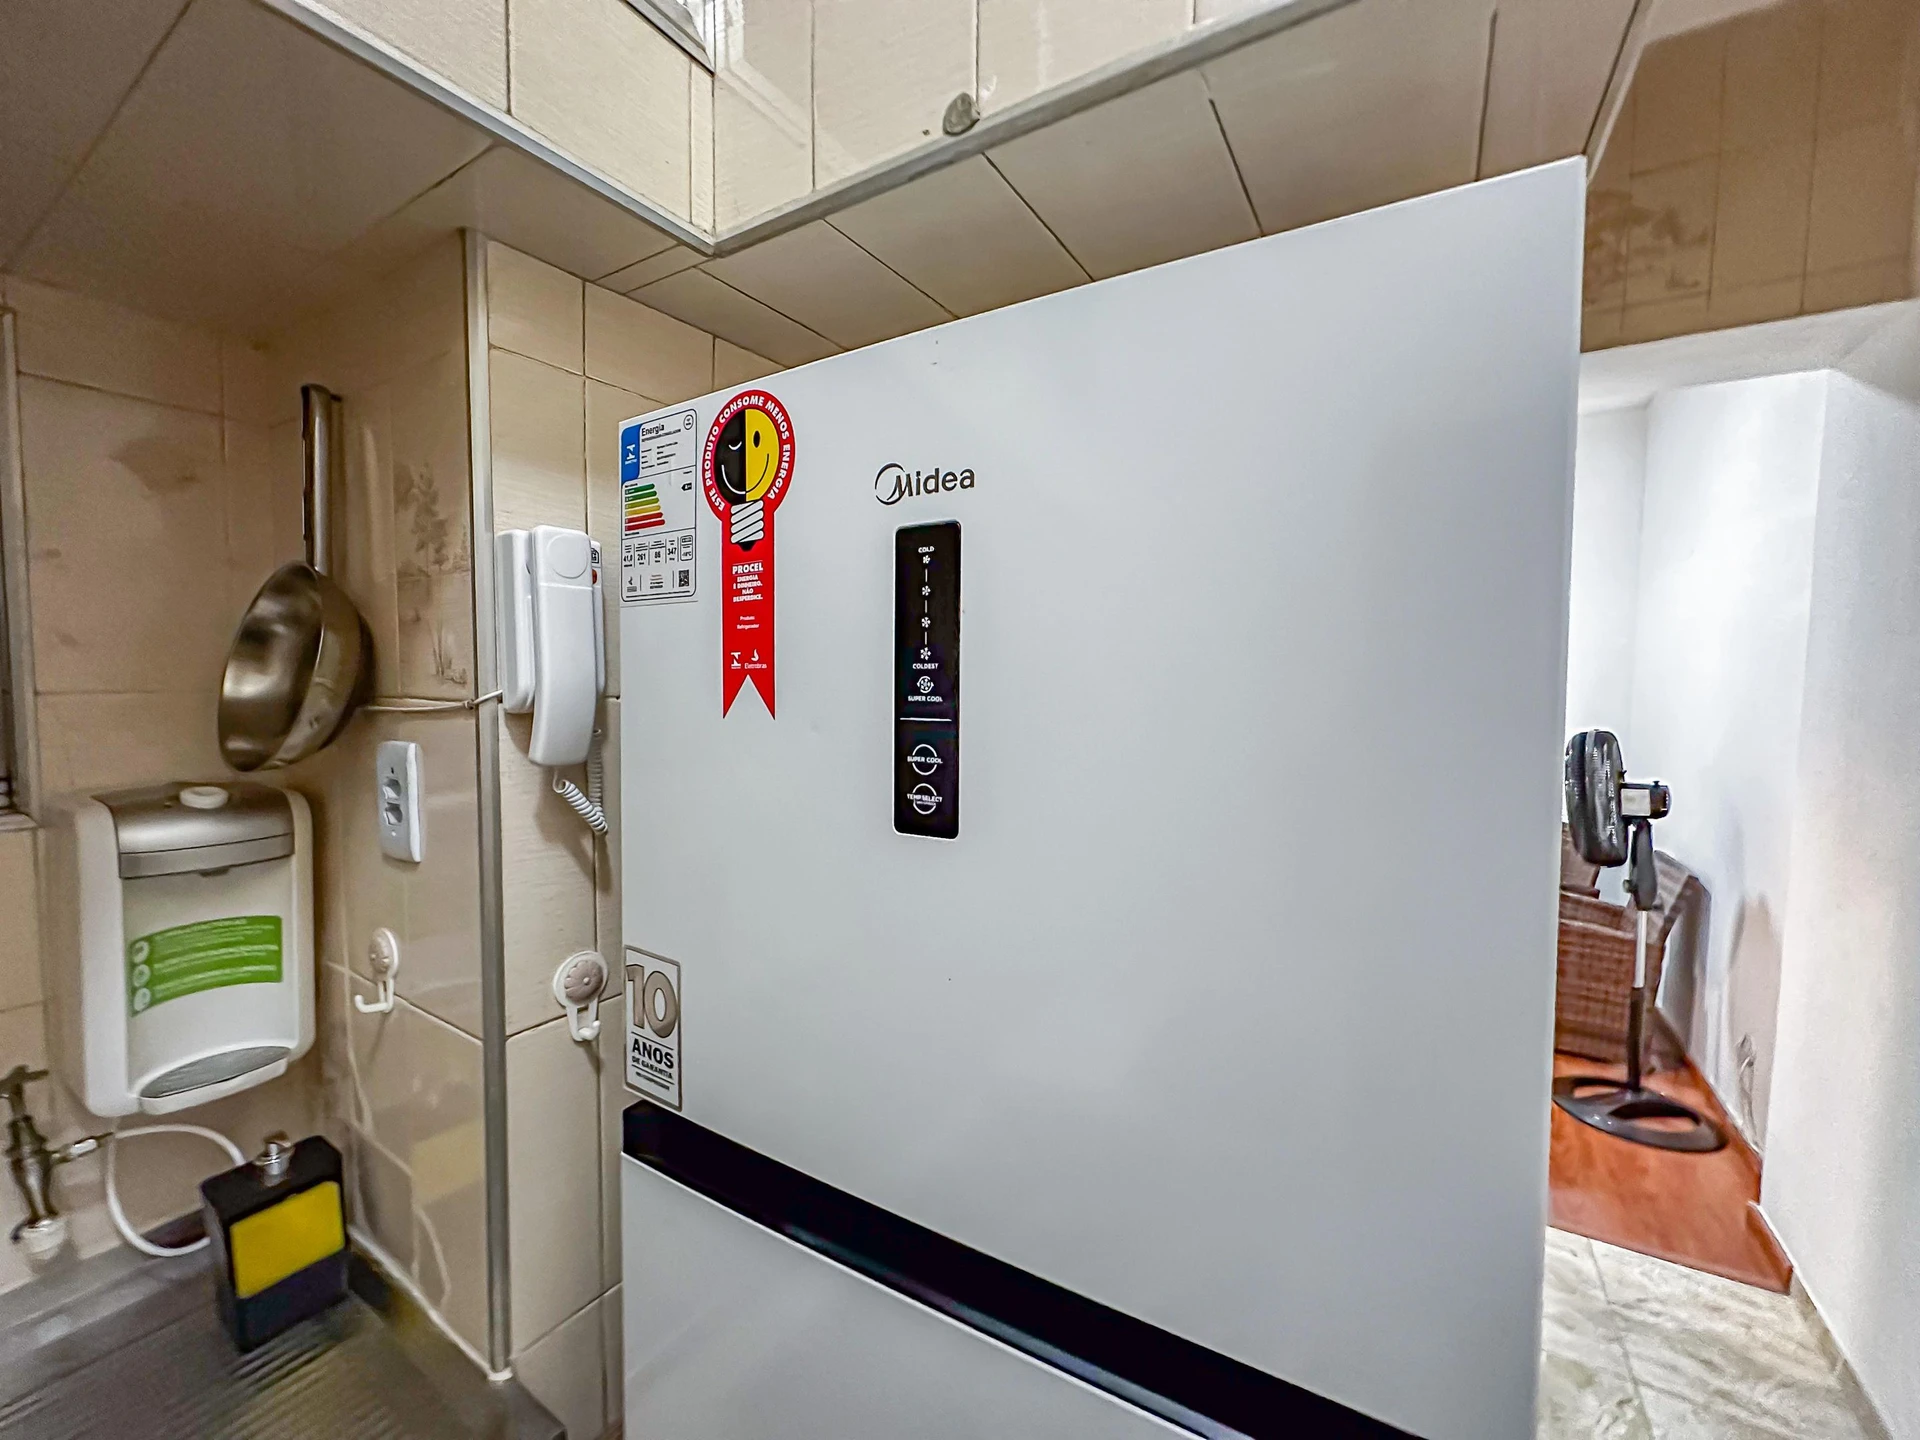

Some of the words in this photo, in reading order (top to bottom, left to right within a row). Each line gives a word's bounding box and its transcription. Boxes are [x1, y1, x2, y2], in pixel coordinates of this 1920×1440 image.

[719, 395, 765, 423] CONSOME
[765, 401, 790, 440] MENOS
[641, 424, 665, 437] Energia
[704, 426, 719, 487] PRODUTO
[767, 444, 791, 499] ENERGIA
[874, 462, 975, 505] Midea
[708, 488, 725, 512] ESTE
[732, 562, 763, 575] PROCEL
[737, 574, 759, 583] ENERGIA
[926, 695, 943, 703] COOL
[625, 964, 678, 1039] 10
[631, 1038, 674, 1069] ANOS
[632, 1055, 641, 1065] DE
